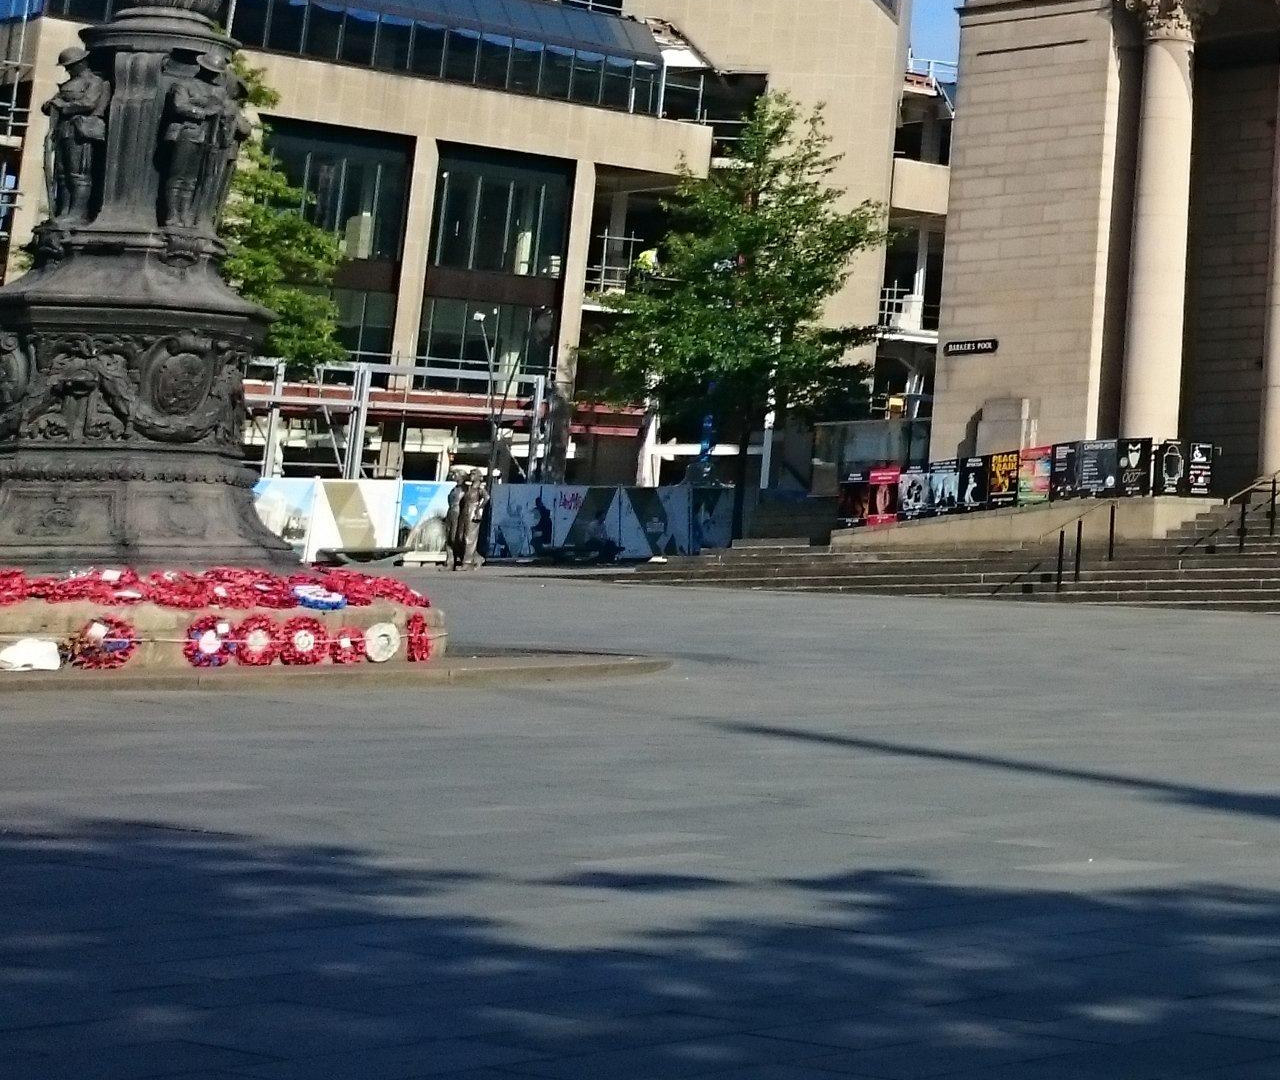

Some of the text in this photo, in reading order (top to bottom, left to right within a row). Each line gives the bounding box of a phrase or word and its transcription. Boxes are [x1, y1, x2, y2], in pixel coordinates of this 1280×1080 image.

[949, 343, 975, 351] BARKER'S
[992, 454, 1018, 463] PEACE
[1122, 471, 1141, 483] 007
